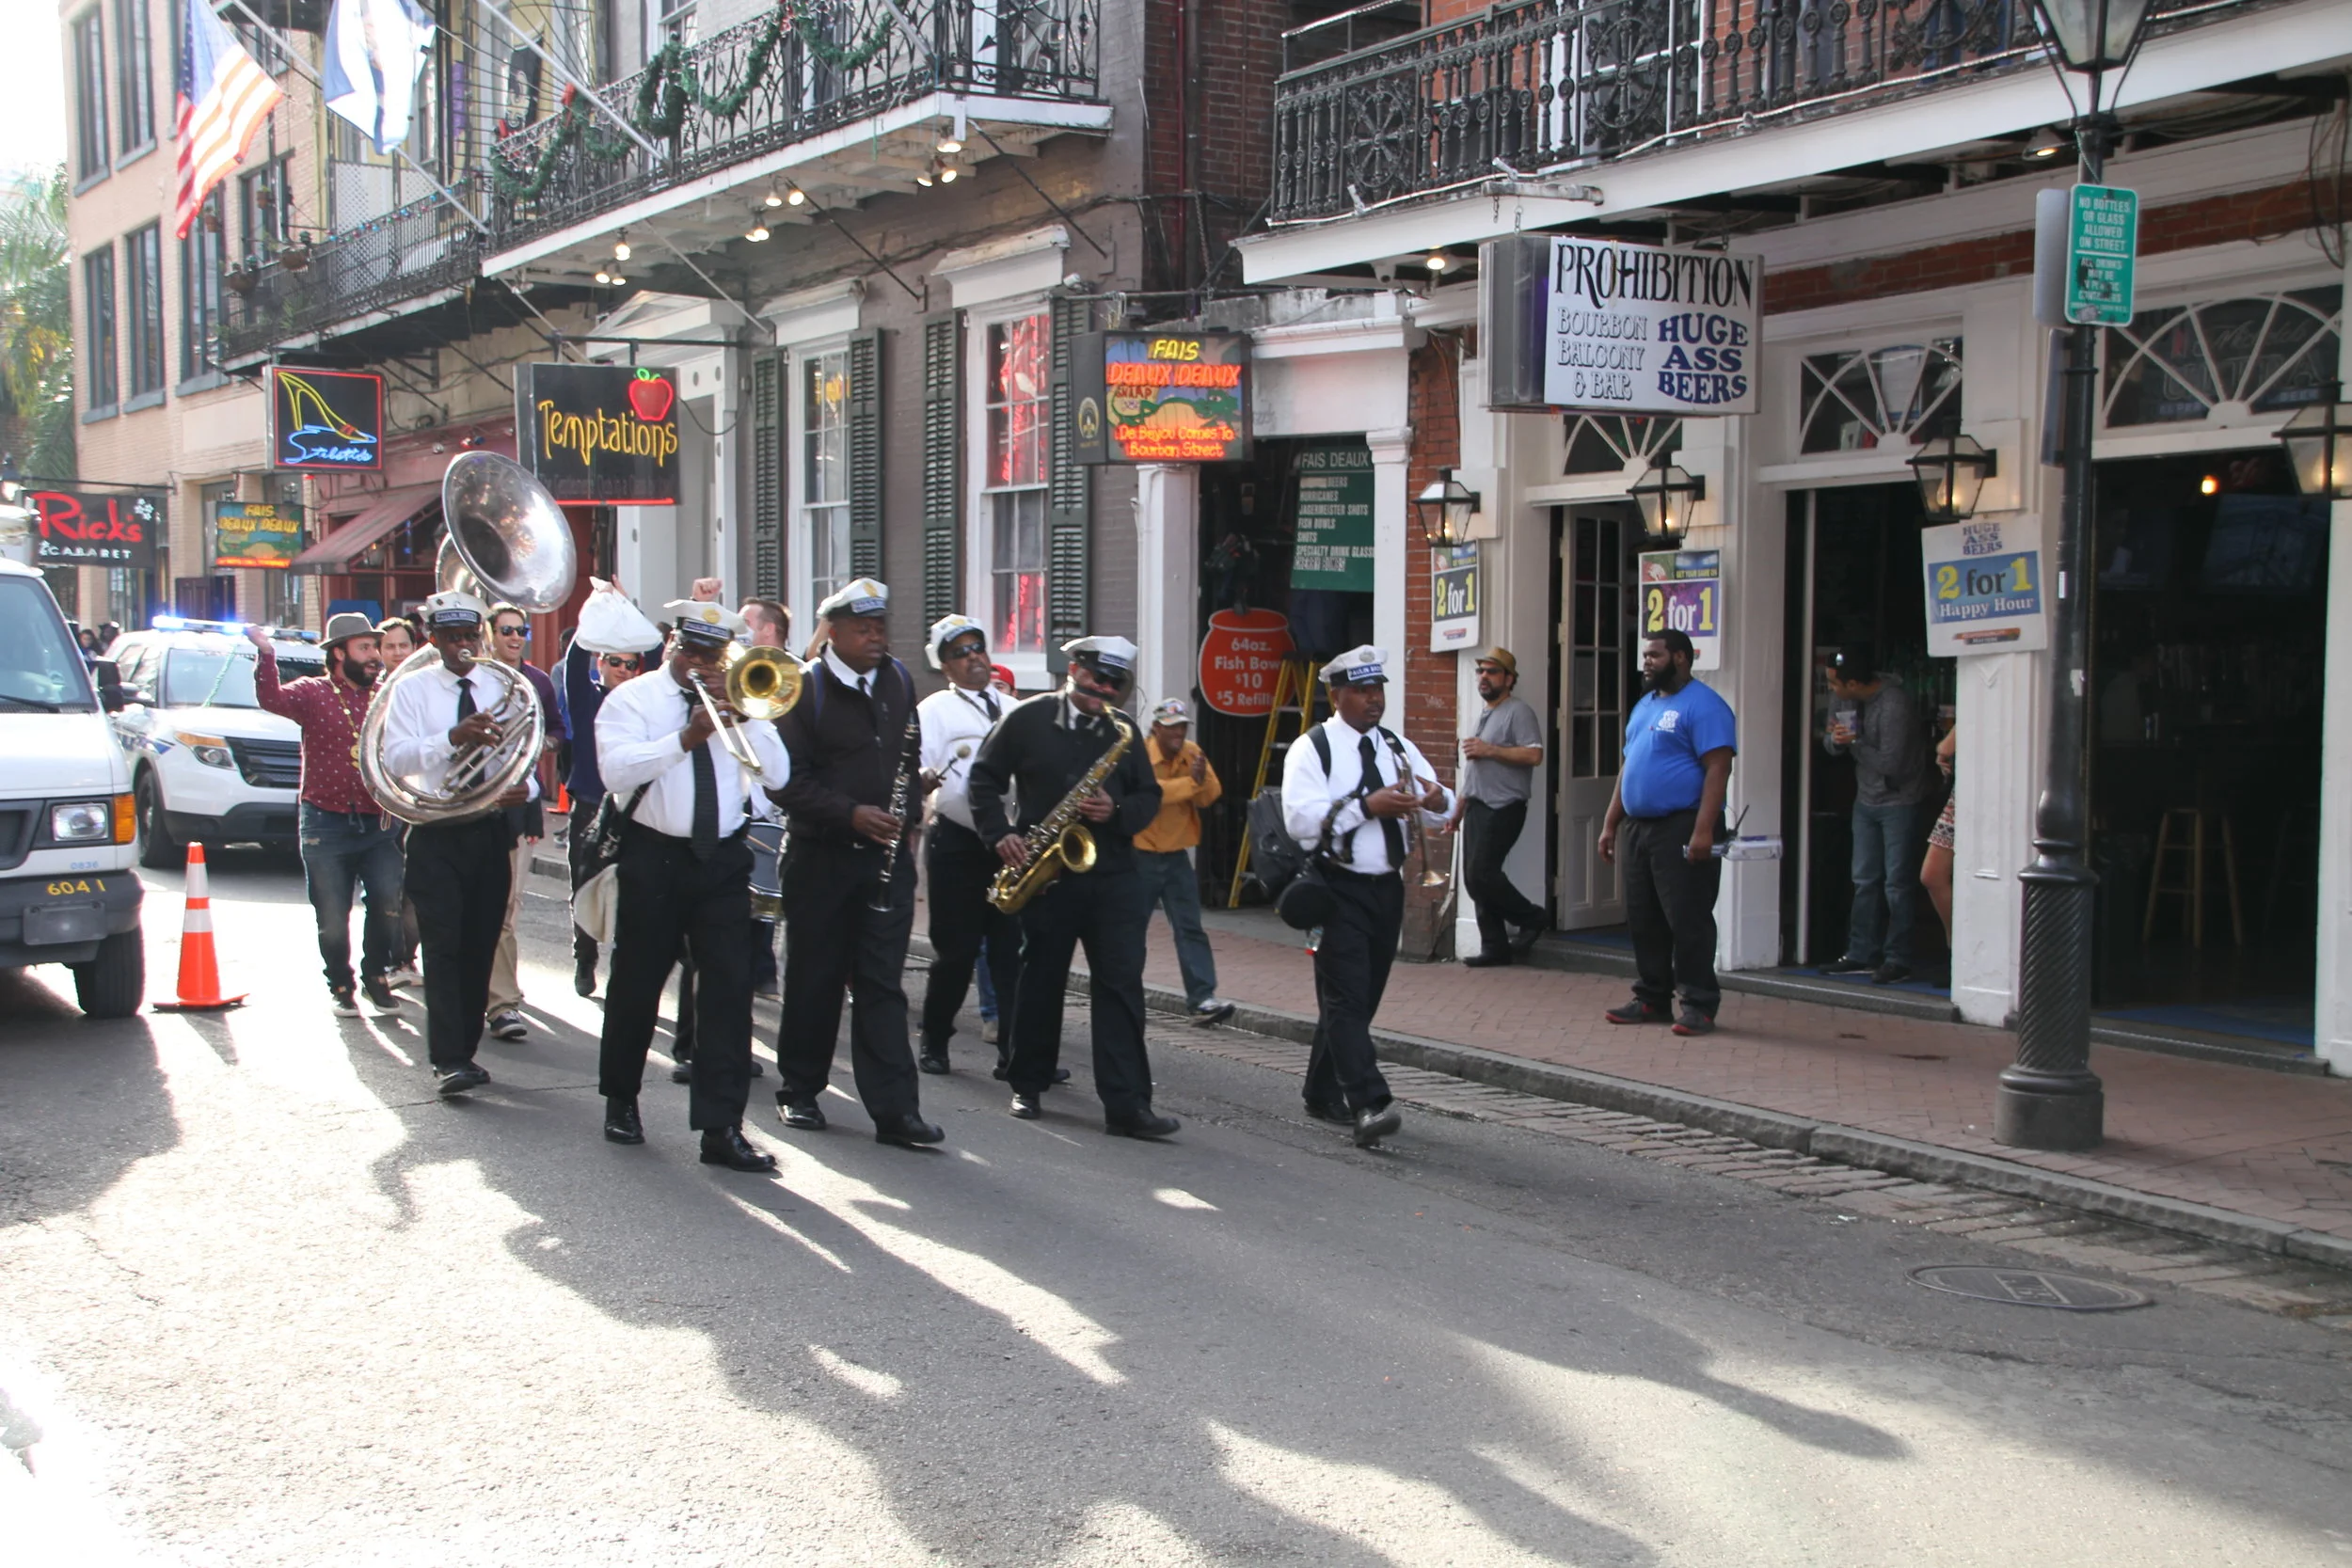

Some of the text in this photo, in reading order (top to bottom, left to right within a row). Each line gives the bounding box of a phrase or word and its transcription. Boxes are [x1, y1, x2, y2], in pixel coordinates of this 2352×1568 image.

[2079, 197, 2130, 213] NO BOTTLES
[2083, 210, 2124, 225] OR GLASS
[2084, 224, 2122, 238] ALLOWED
[2079, 236, 2125, 251] ON STREET
[1555, 243, 1753, 310] PROHIBITION
[1557, 307, 1648, 341] BOURBON
[1658, 313, 1748, 346] HUGE
[1151, 340, 1200, 361] FAIS
[1557, 339, 1645, 371] BALCONY
[1661, 345, 1742, 372] ASS
[1107, 364, 1242, 387] DEAUX DEAUX
[1590, 372, 1632, 401] BAR
[1658, 372, 1747, 404] BEERS
[538, 400, 678, 467] Temptations
[1178, 426, 1217, 440] Comes
[1218, 425, 1234, 441] To
[1129, 441, 1224, 457] Bourbon Street
[1302, 452, 1369, 467] FAIS DEAUX
[1299, 490, 1339, 501] HURRICANES
[30, 491, 143, 543] Rick's
[244, 504, 275, 516] FAIS
[1298, 504, 1369, 515] JAGERMEISTER SHOTS
[1297, 517, 1336, 530] FISH BOWLS
[1963, 523, 2000, 535] HUGE
[1297, 531, 1317, 543] SHOTS
[1964, 532, 1999, 545] ASS
[49, 546, 132, 559] CABARET
[1295, 546, 1328, 556] SPECIALTY
[1963, 541, 2003, 555] BEERS
[1937, 557, 2032, 599] 2 for 1
[1437, 572, 1475, 617] 2 for 1
[1647, 587, 1713, 632] 2 for 1
[1940, 597, 2035, 619] Happy Hour
[1231, 638, 1272, 651] 64oz.
[1215, 656, 1280, 670] Fish Bow
[1235, 673, 1263, 688] $10
[1216, 690, 1275, 706] $5 Refill
[47, 879, 105, 895] 6041
